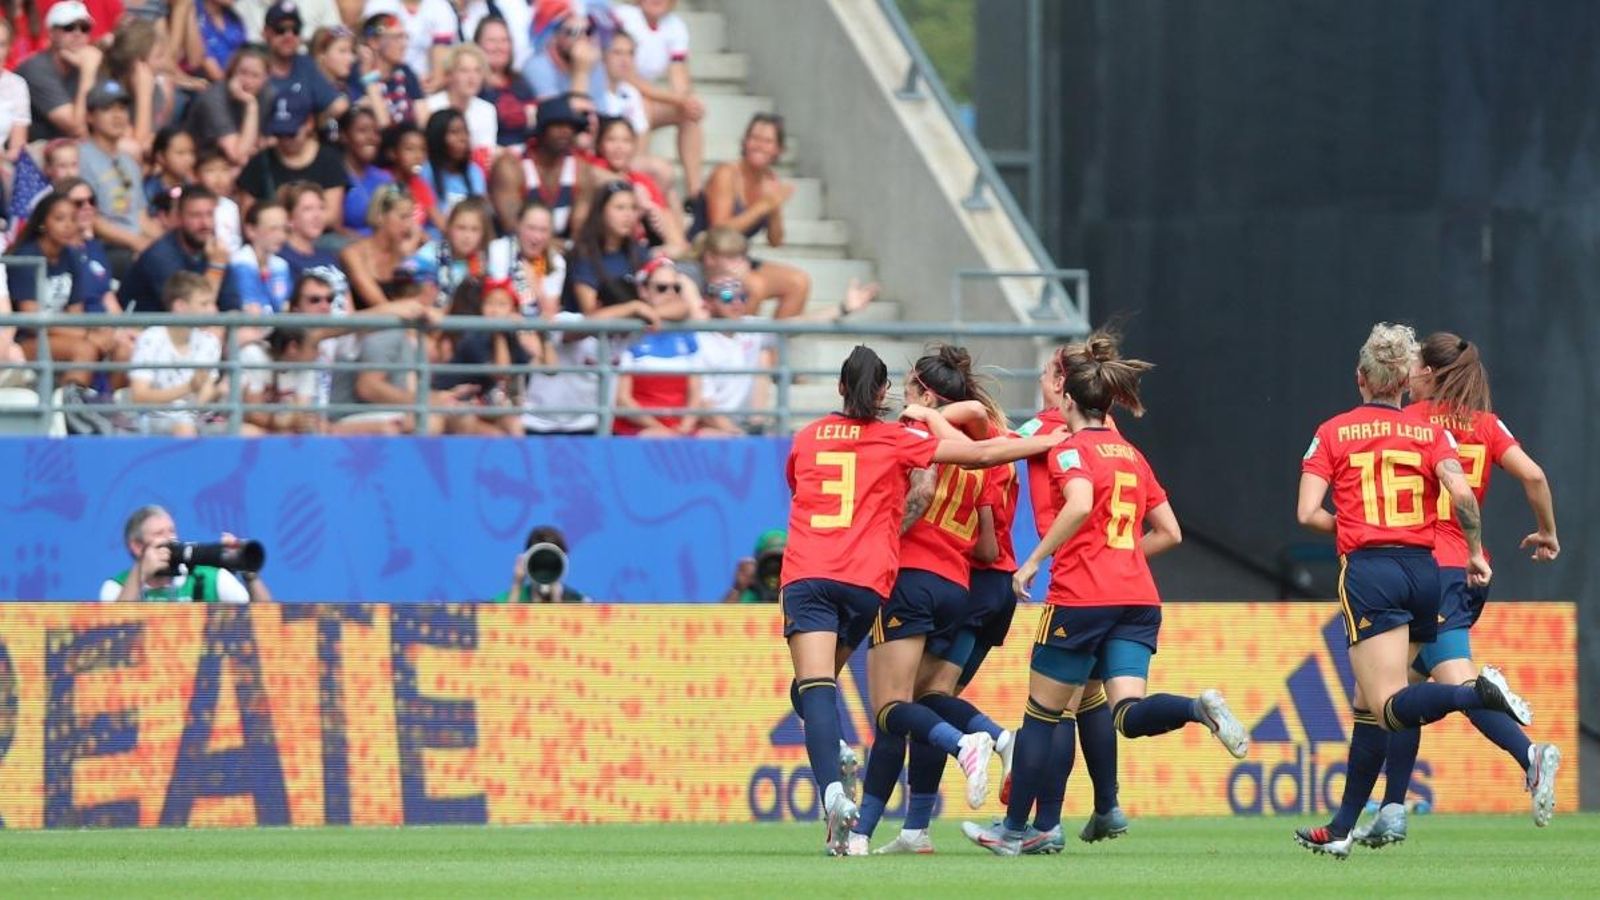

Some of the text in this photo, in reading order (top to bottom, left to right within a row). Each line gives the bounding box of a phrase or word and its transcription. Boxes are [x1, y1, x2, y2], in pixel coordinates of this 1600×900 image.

[816, 425, 861, 441] LEILA
[810, 452, 857, 528] 3
[924, 463, 984, 542] 10
[1106, 470, 1138, 550] 6
[1349, 449, 1425, 527] 16
[0, 603, 488, 827] EATE
